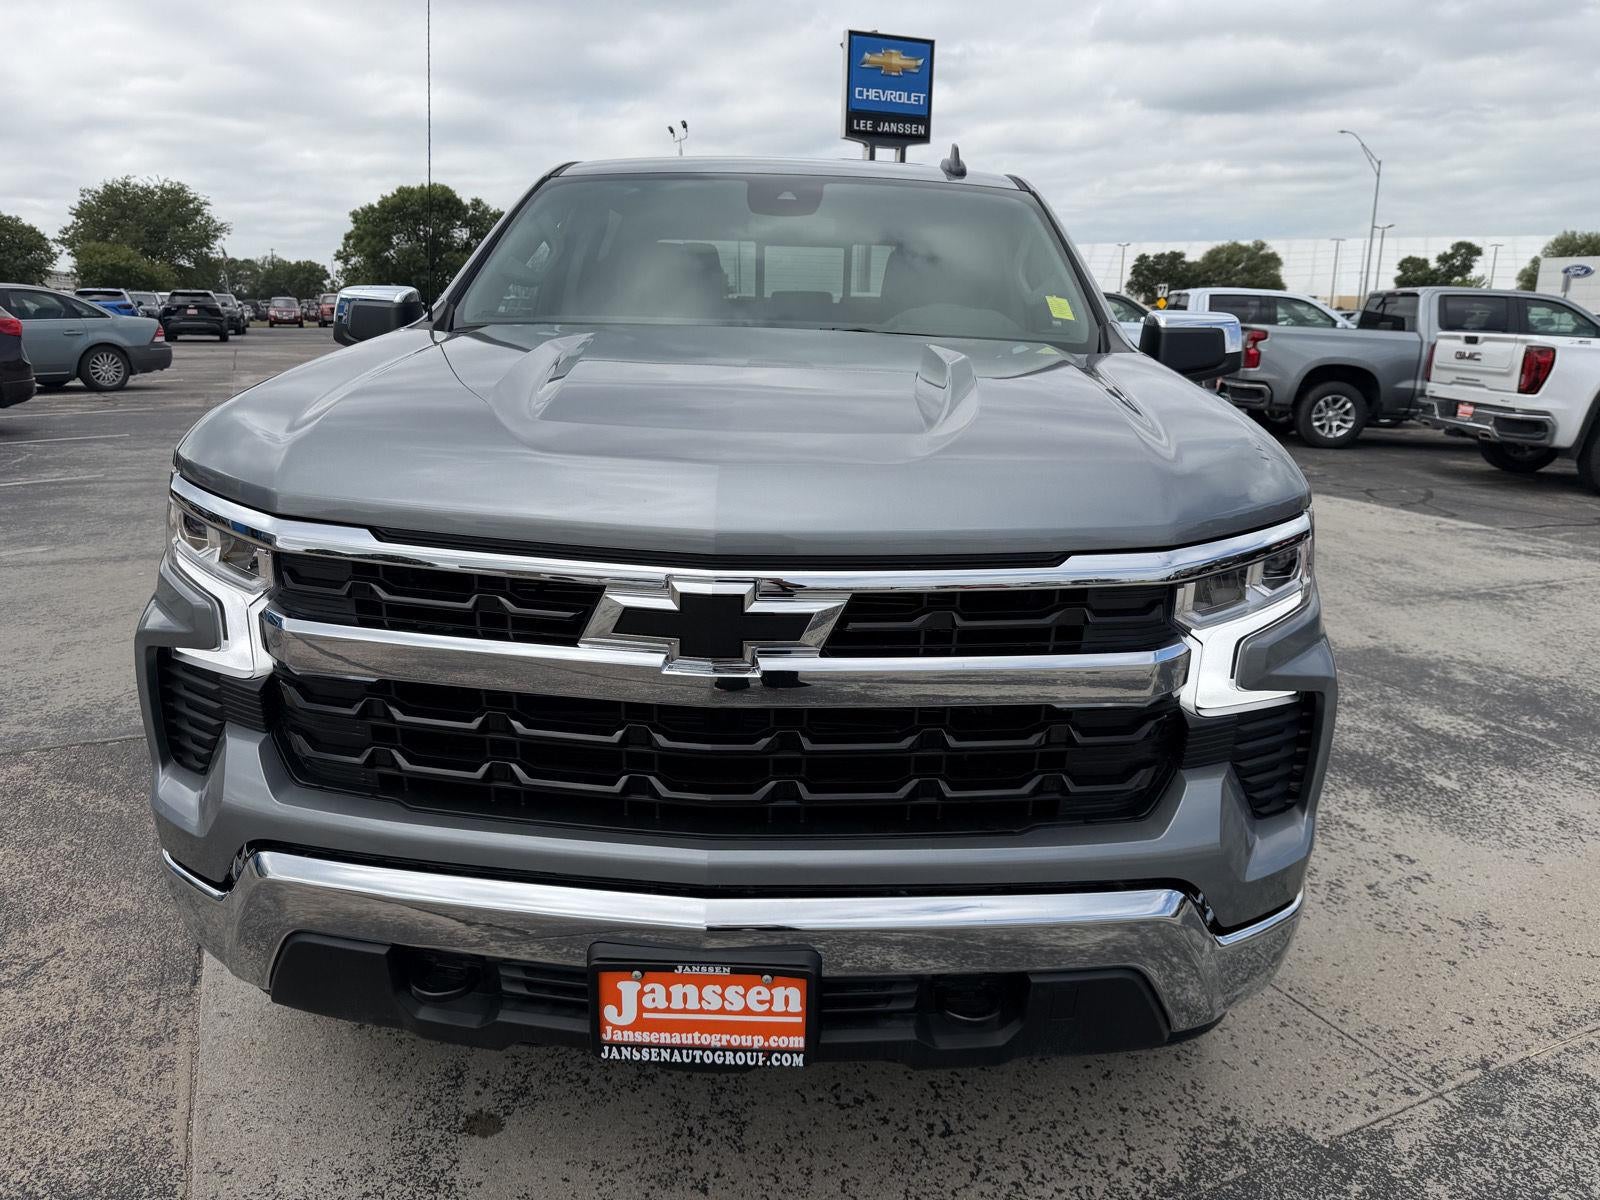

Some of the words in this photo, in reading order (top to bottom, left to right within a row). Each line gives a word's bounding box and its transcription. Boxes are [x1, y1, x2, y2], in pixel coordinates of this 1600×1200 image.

[855, 87, 926, 105] CHEVROLET
[853, 119, 873, 131] LEE
[877, 122, 925, 135] JANSSEN
[1455, 350, 1482, 361] GMC
[674, 965, 731, 974] JANSSEN
[603, 980, 802, 1026] Janssen
[601, 1025, 805, 1049] Janssenautogroup.com
[600, 1045, 804, 1067] JANSSENAUTOGROUP.COM
